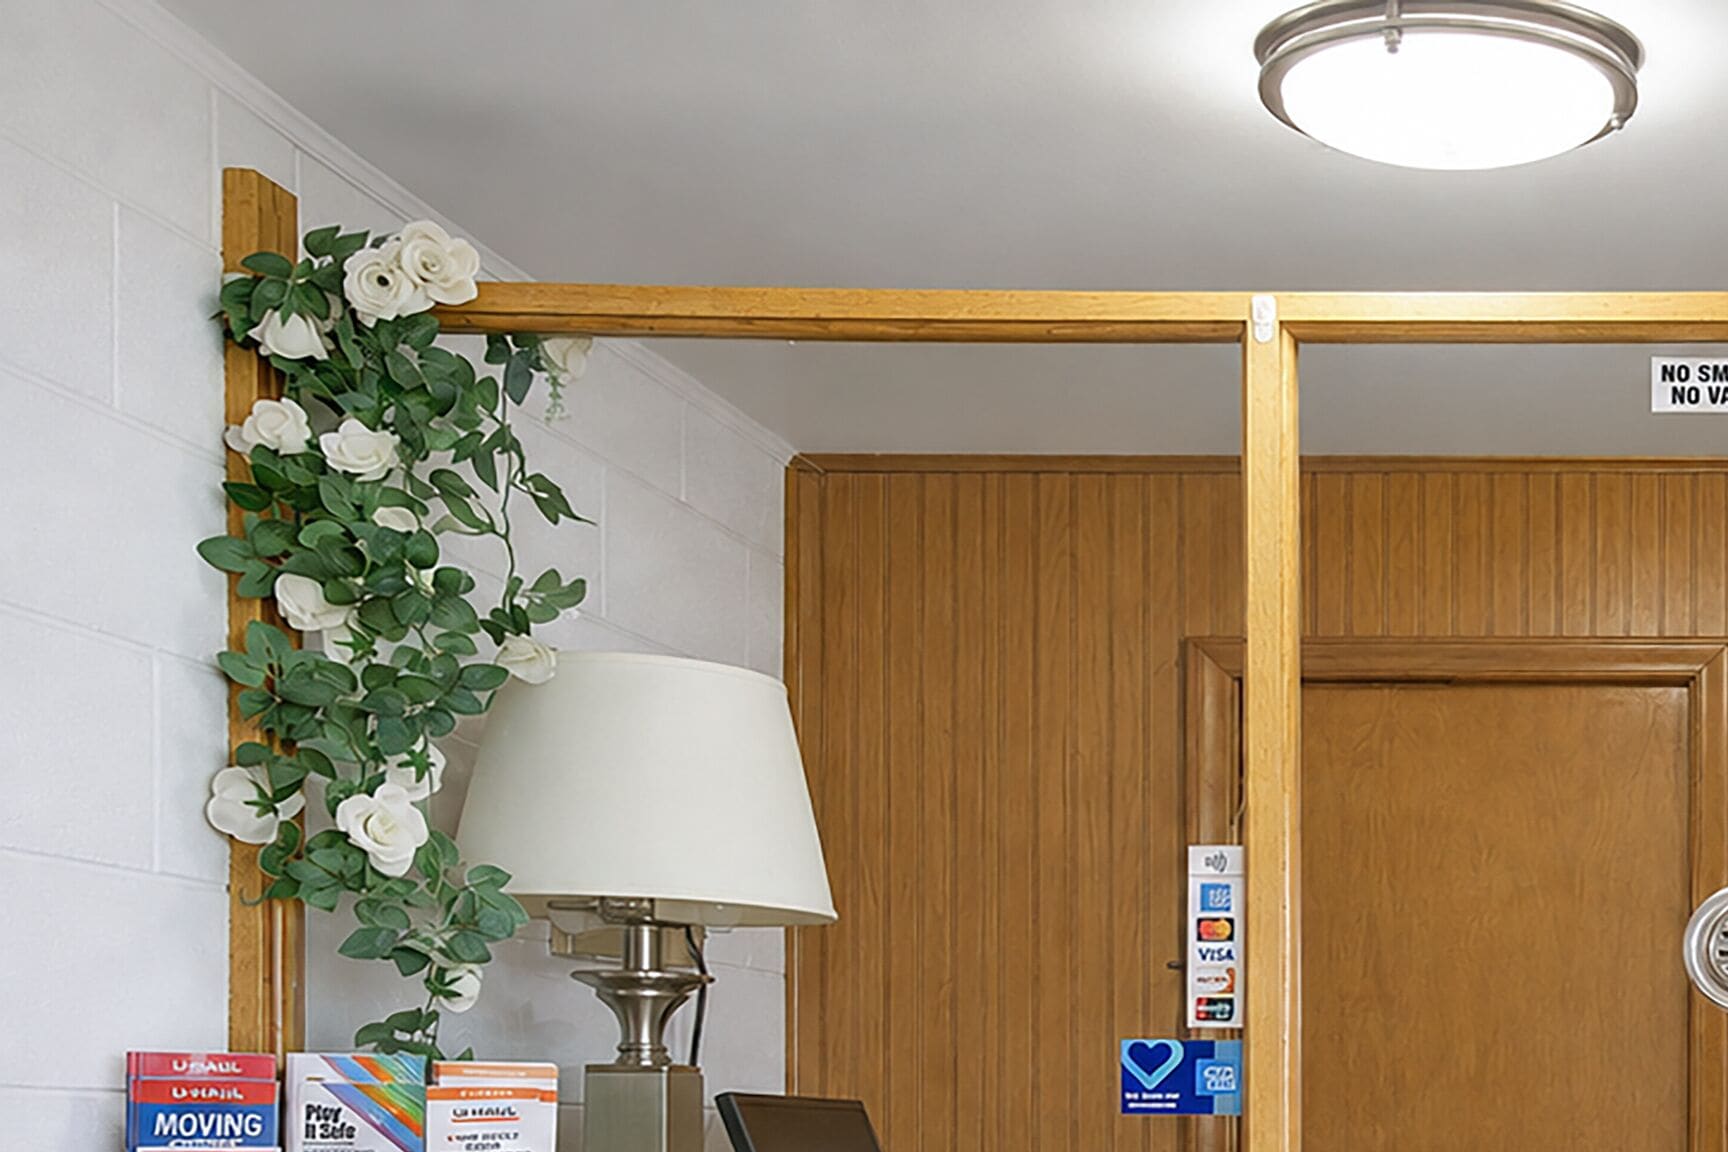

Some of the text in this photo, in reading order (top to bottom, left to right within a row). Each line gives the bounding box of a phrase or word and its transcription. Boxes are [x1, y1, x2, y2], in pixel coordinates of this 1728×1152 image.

[1661, 364, 1690, 382] NO
[1671, 386, 1700, 404] NO
[1198, 947, 1235, 961] VISA
[154, 1112, 262, 1137] MOVING
